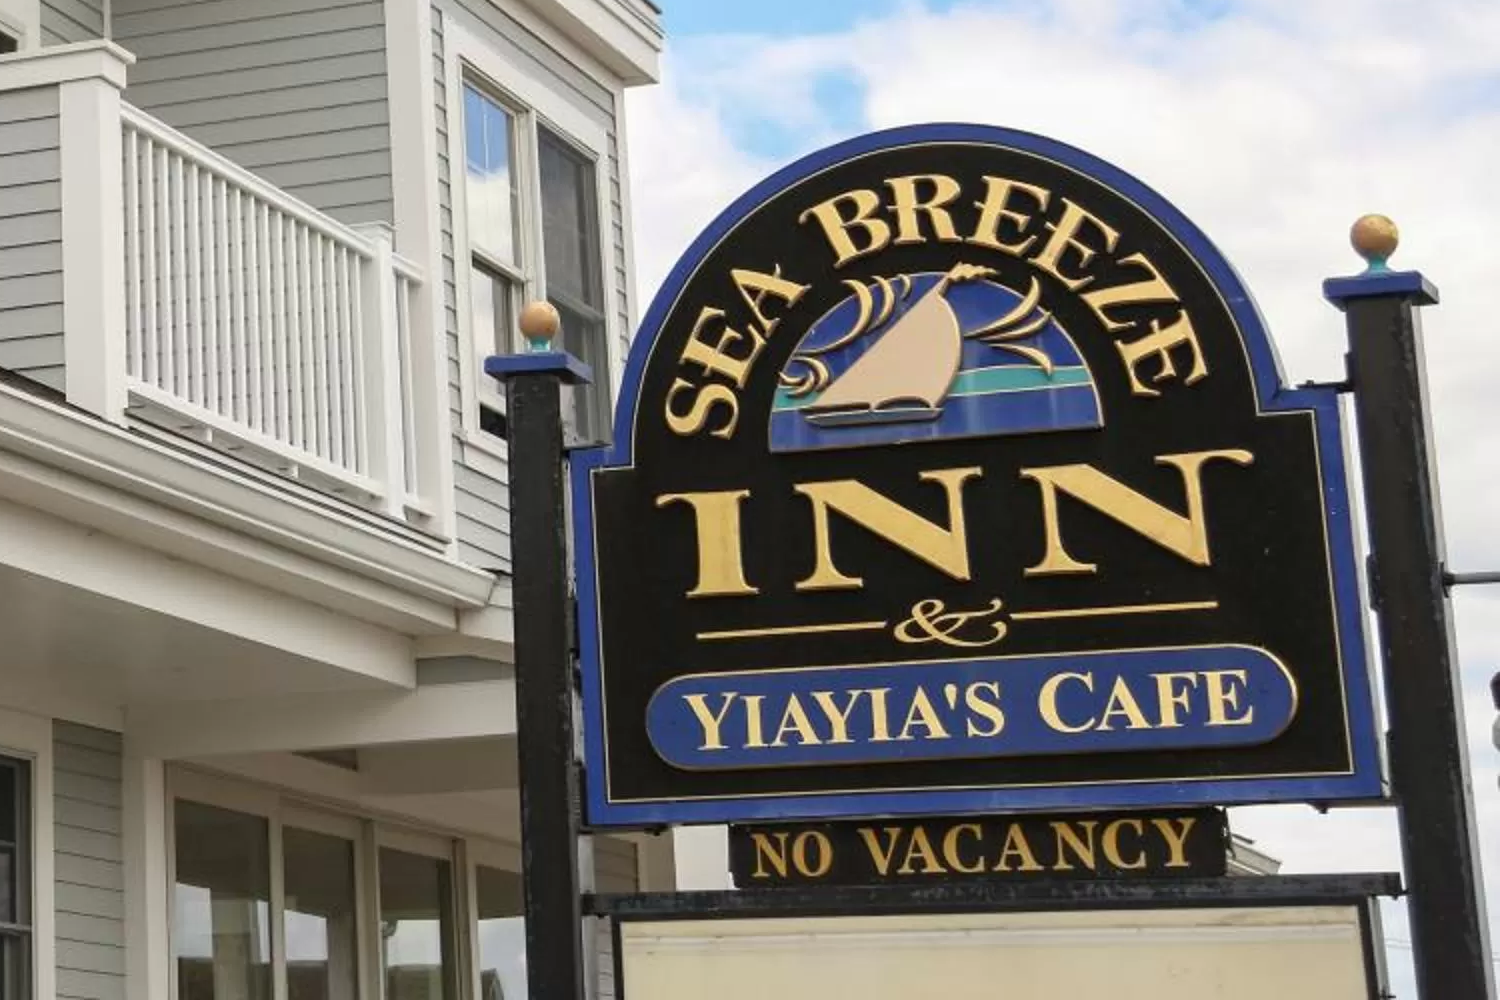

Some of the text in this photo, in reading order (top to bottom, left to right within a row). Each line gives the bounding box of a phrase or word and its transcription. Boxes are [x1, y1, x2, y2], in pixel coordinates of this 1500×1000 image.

[665, 174, 1208, 439] SEA BREEZE
[657, 449, 1254, 597] INN
[894, 598, 1008, 646] &
[683, 669, 1253, 750] YIAYIA'S CAFE
[752, 817, 1197, 879] NO VACANCY
